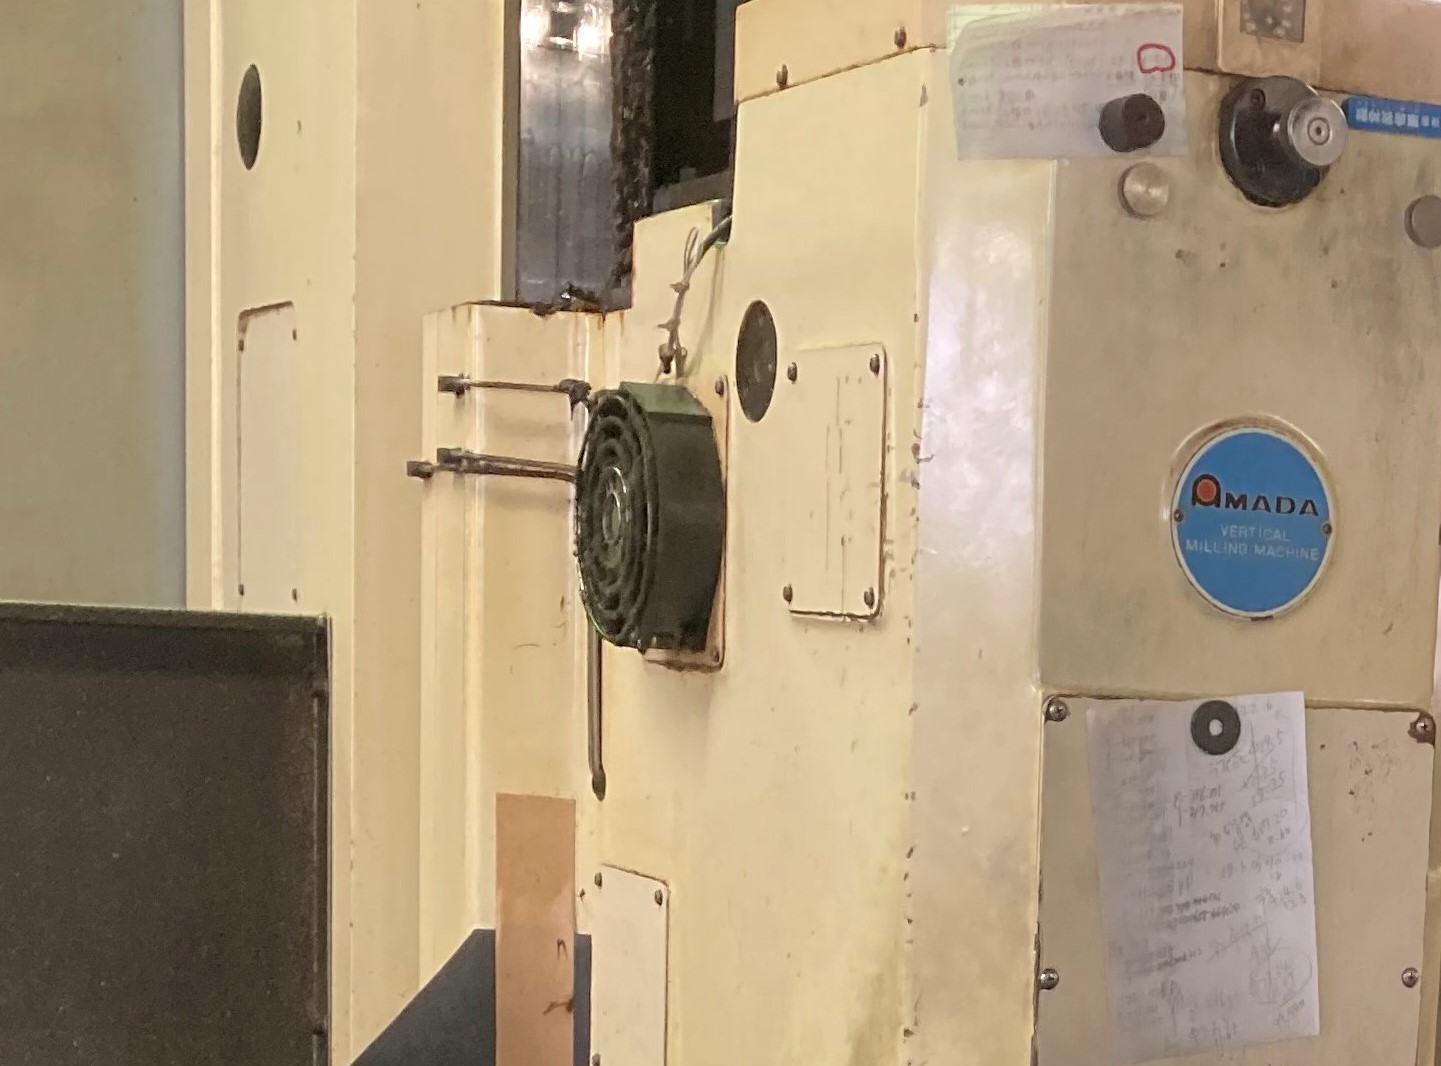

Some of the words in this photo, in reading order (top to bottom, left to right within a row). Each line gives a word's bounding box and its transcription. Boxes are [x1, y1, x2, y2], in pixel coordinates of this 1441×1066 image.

[1191, 474, 1319, 517] AMADA
[1220, 523, 1290, 543] VERTICAL
[1185, 538, 1248, 555] MILLING
[1254, 545, 1319, 561] MACHINE
